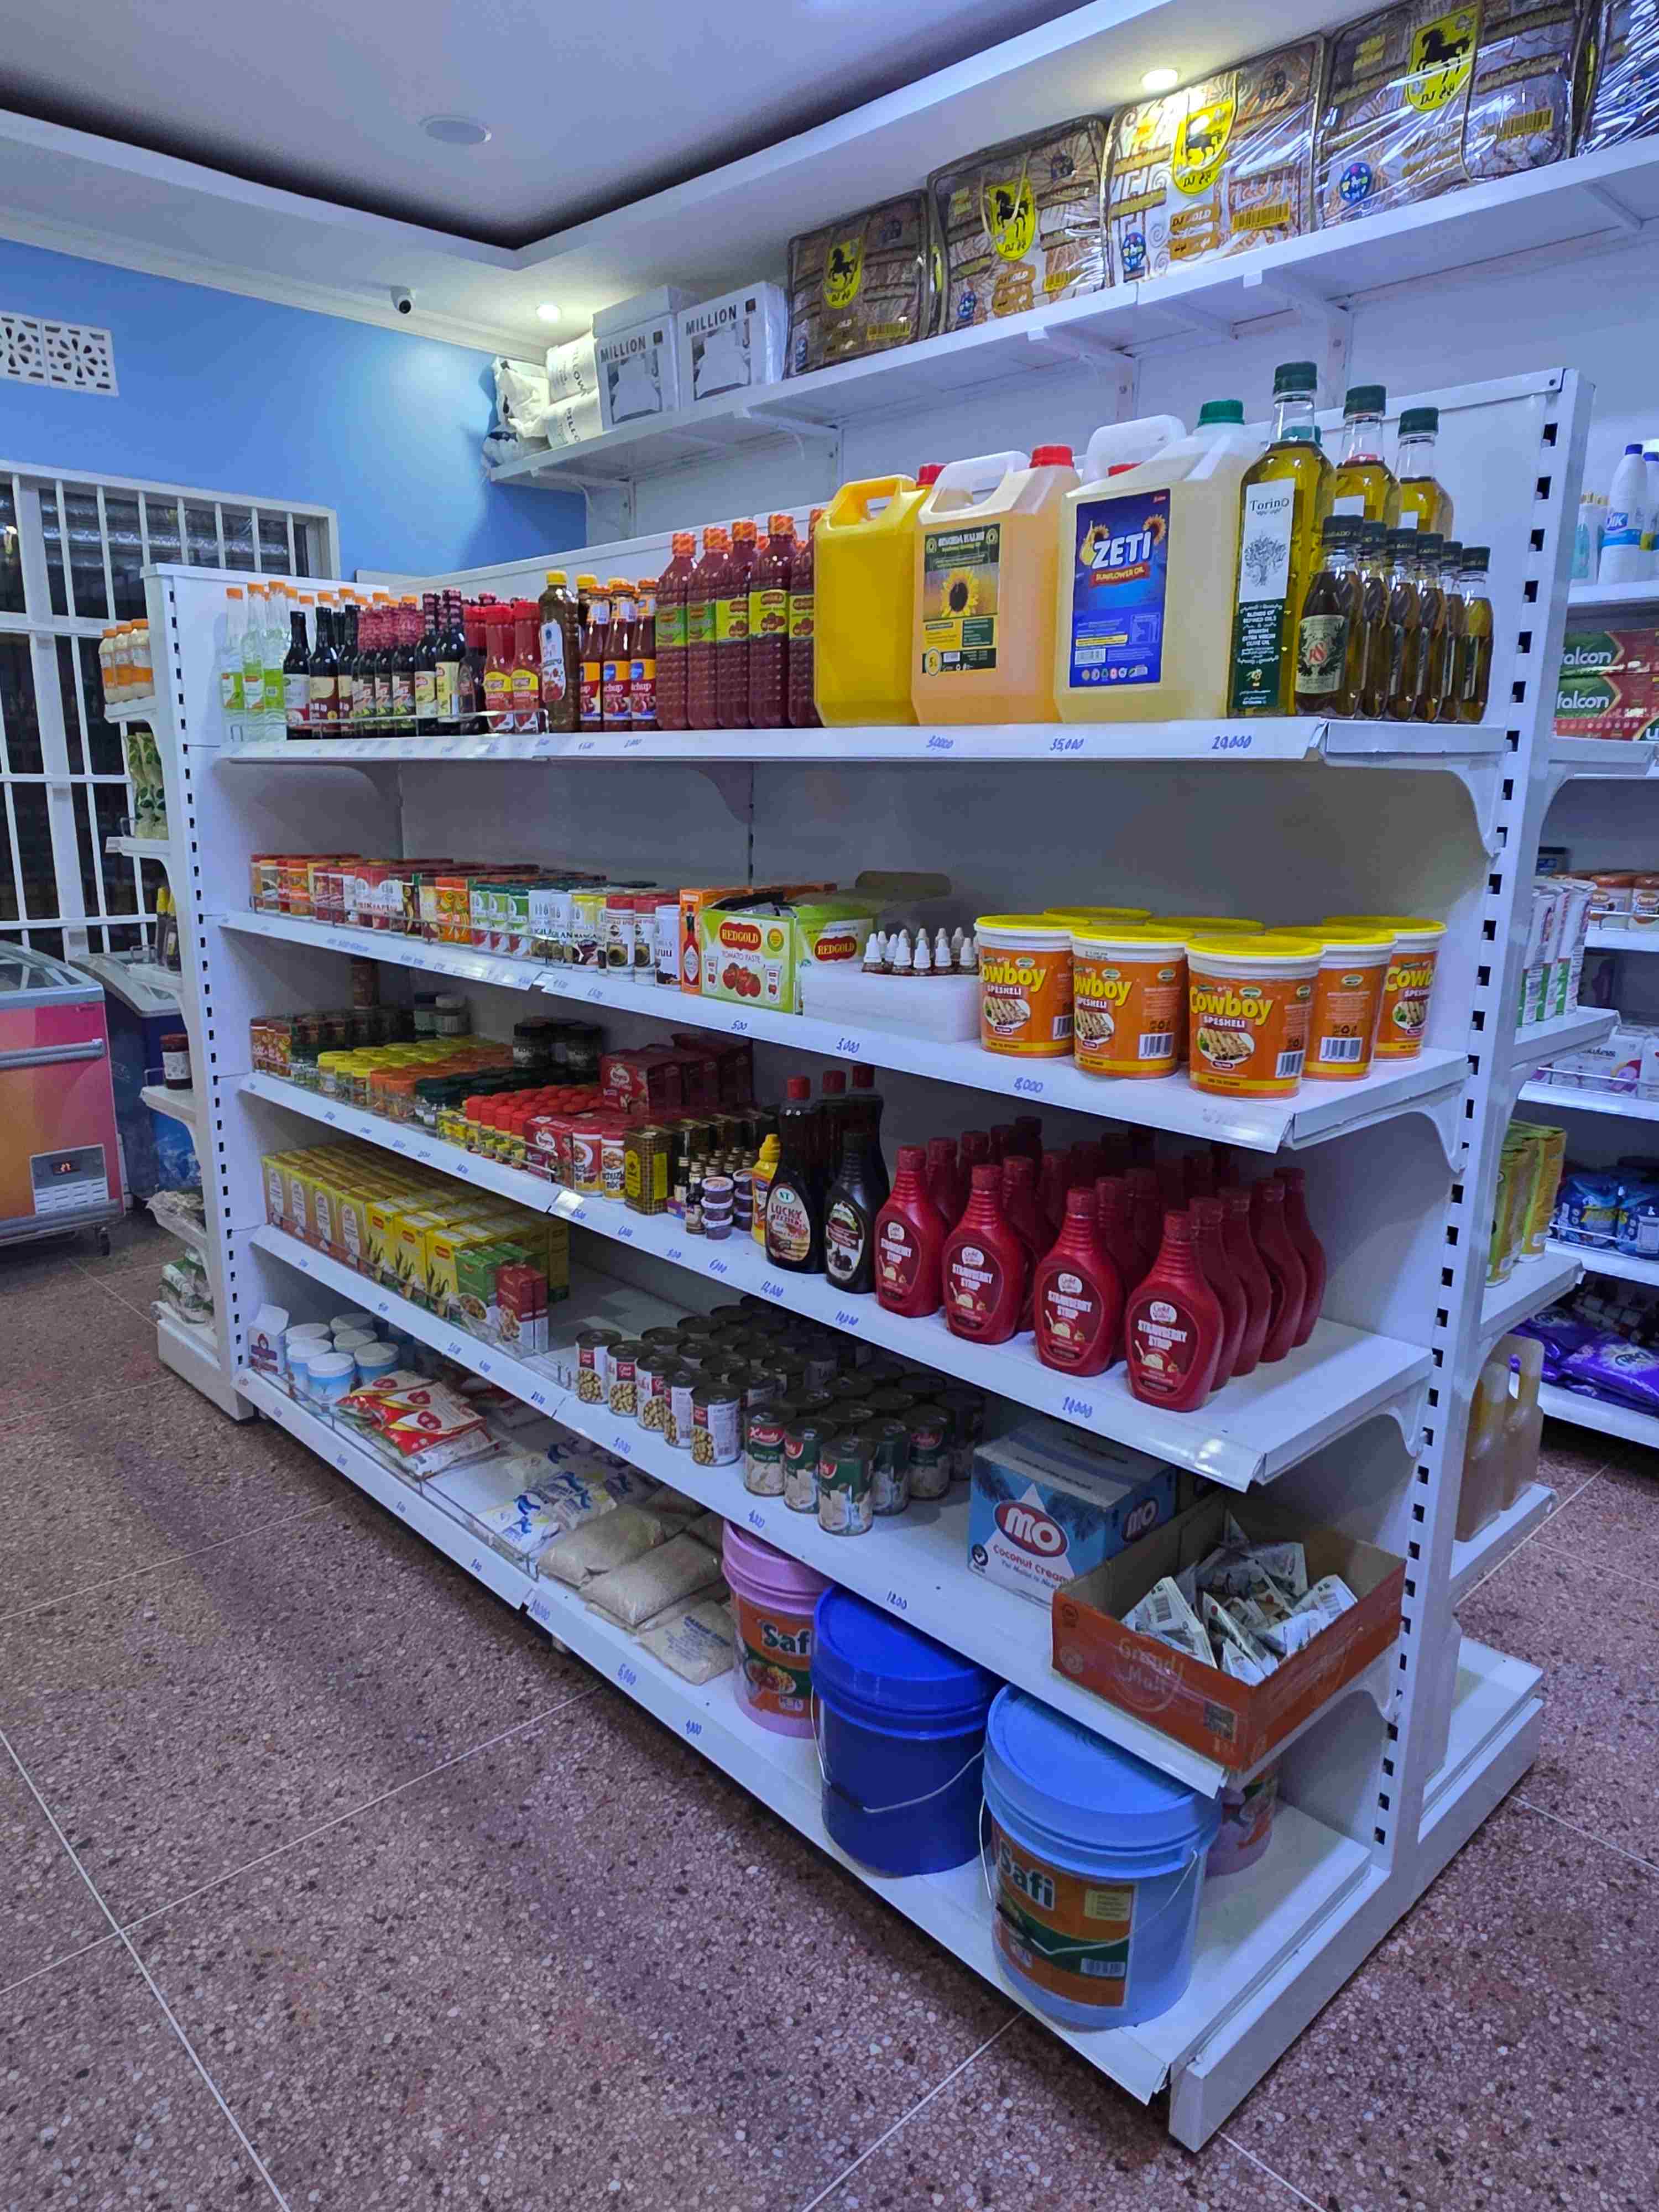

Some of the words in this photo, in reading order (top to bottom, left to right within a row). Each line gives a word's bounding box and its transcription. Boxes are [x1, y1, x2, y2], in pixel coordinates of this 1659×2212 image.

[686, 305, 737, 336] MILLION
[599, 336, 646, 363] MILLION
[1092, 531, 1151, 569] ZETI
[1563, 646, 1612, 665] alcon
[1557, 691, 1609, 709] falcon
[722, 928, 759, 944] REDGOLD
[721, 950, 744, 961] TOMATO
[818, 943, 855, 956] REDGOLD
[1190, 986, 1274, 1026] Cowboy
[1203, 1015, 1246, 1028] SPESHELI
[771, 1206, 803, 1219] LUCKY
[993, 1544, 1032, 1569] Coconut
[763, 1623, 810, 1656] Saf
[998, 1839, 1055, 1911] Safi
